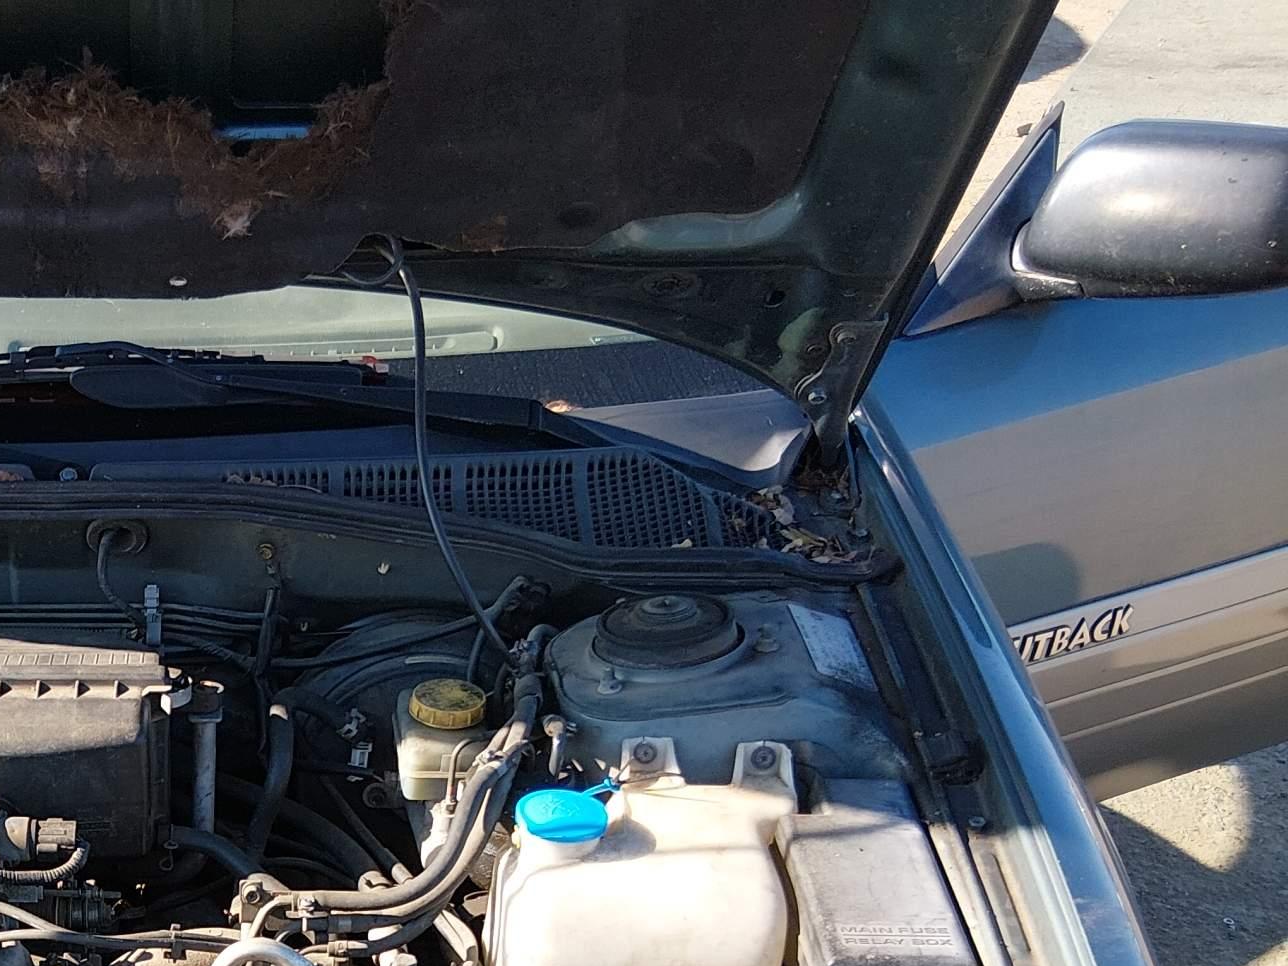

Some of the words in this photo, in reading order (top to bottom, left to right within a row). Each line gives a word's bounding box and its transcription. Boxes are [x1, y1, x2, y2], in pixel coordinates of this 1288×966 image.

[1013, 604, 1134, 662] UTBACK
[840, 926, 893, 934] MAIN
[898, 926, 951, 934] FUSE
[844, 938, 905, 946] RELAY
[911, 938, 954, 946] BOX
